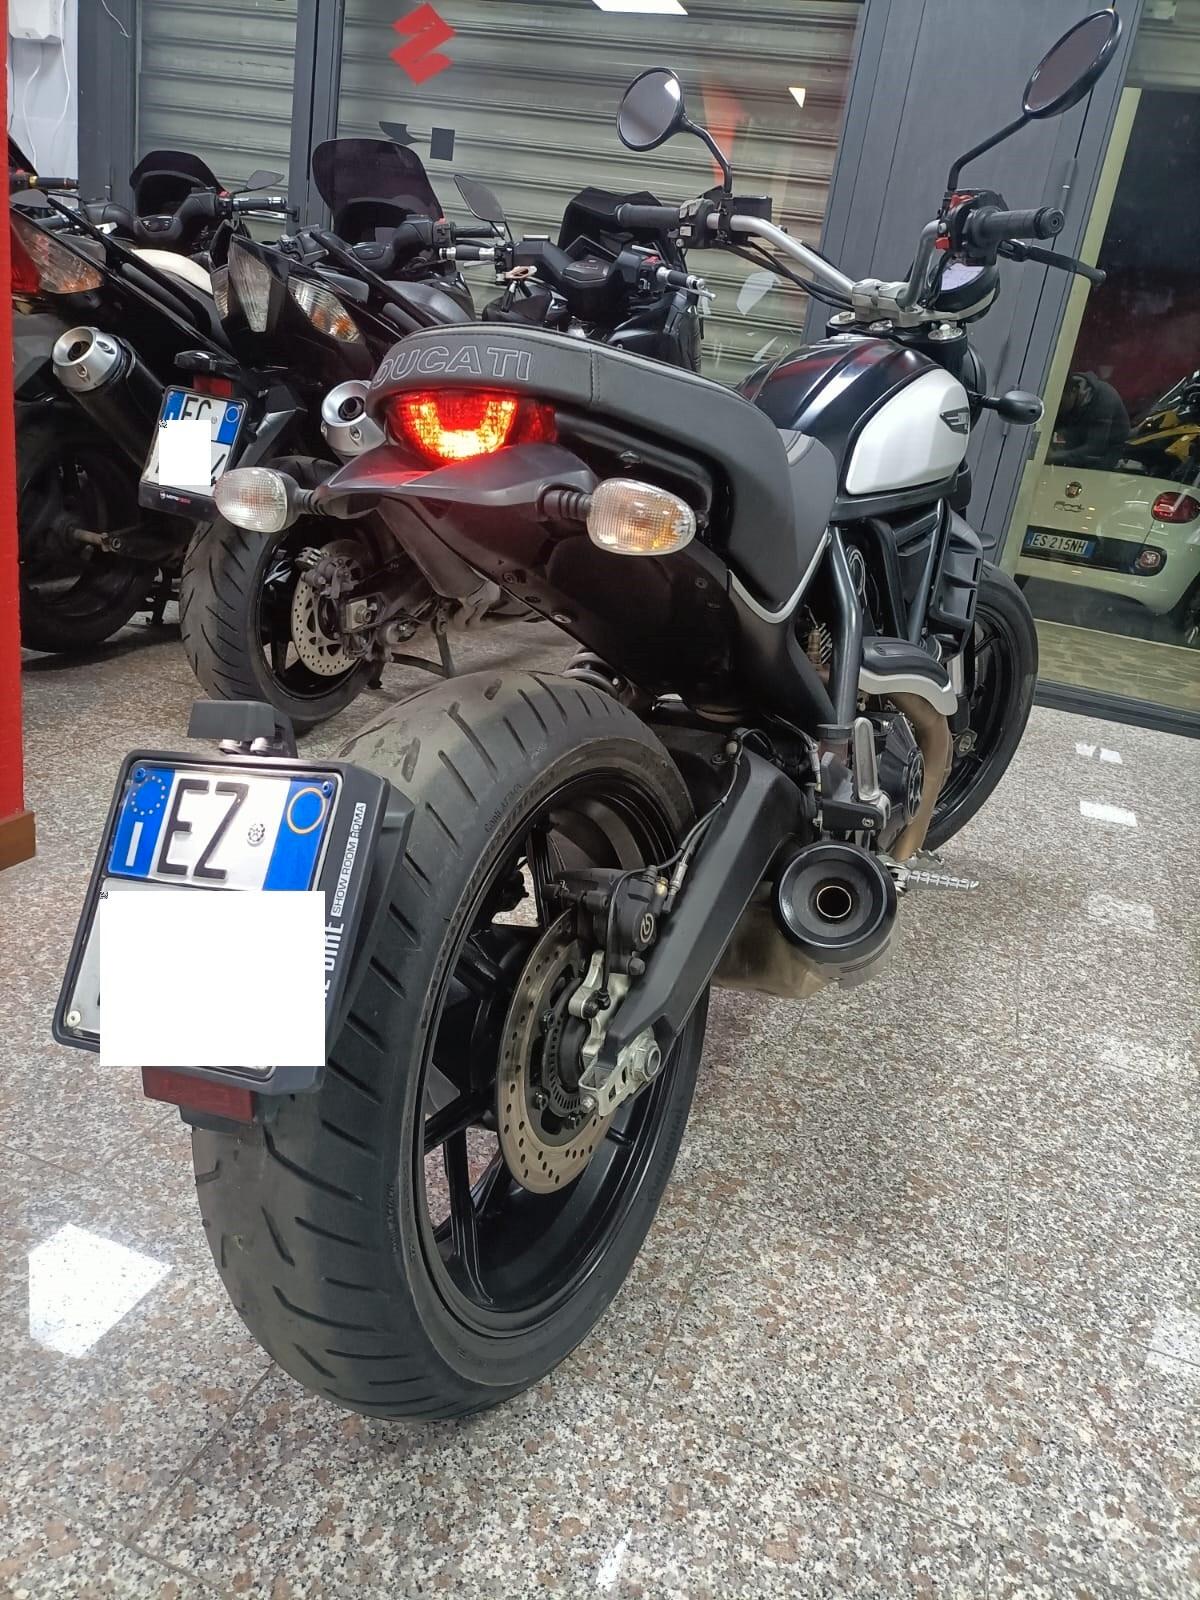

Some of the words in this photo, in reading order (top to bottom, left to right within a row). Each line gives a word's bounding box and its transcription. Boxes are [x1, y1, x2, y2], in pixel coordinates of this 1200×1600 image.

[371, 345, 532, 389] DUCATI
[1032, 534, 1050, 547] ES
[1049, 536, 1087, 553] 215NH
[156, 778, 250, 880] EZ
[333, 878, 349, 914] SHOW
[341, 841, 357, 876] ROOM
[350, 804, 366, 839] ROMA
